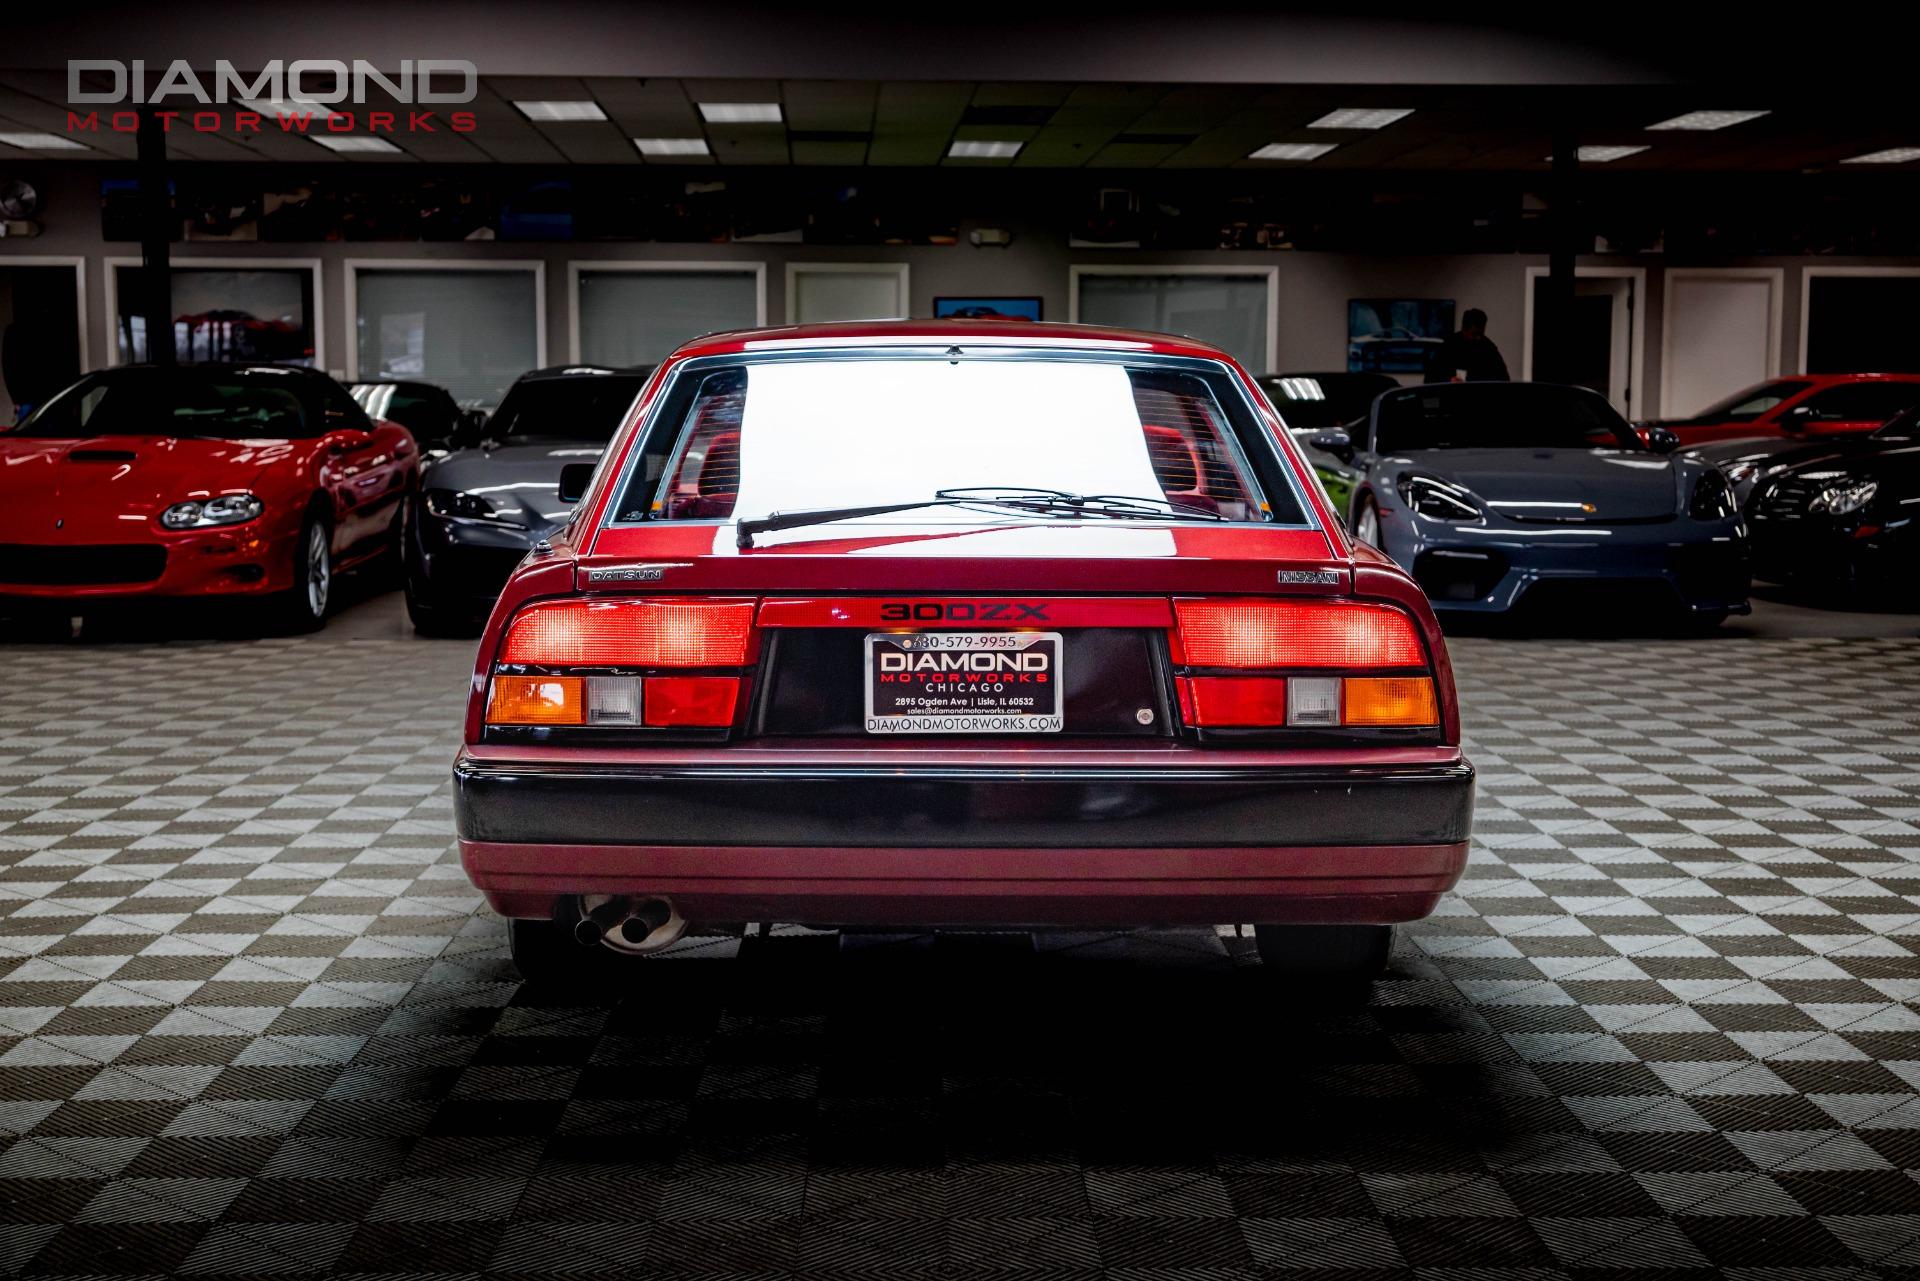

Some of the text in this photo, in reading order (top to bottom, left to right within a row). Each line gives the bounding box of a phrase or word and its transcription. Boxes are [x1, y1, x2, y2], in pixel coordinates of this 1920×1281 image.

[591, 570, 661, 580] DATSUN
[1281, 571, 1336, 582] NISSAN
[880, 603, 1049, 621] 300ZX
[912, 636, 1016, 649] 630-579-9955
[880, 652, 1048, 672] DIAMOND
[880, 673, 1048, 683] MOTORWORKS
[925, 683, 1004, 693] CHICAGO
[895, 697, 916, 706] 2895
[917, 697, 948, 707] Ogden
[950, 697, 968, 706] Ave
[977, 697, 998, 707] Lisle,
[999, 697, 1007, 706] IL
[1008, 697, 1034, 706] 60532
[906, 707, 1022, 715] sales@diamondmotorworks.com
[867, 717, 1061, 732] DIAMONDMOTORWORKS.COM
